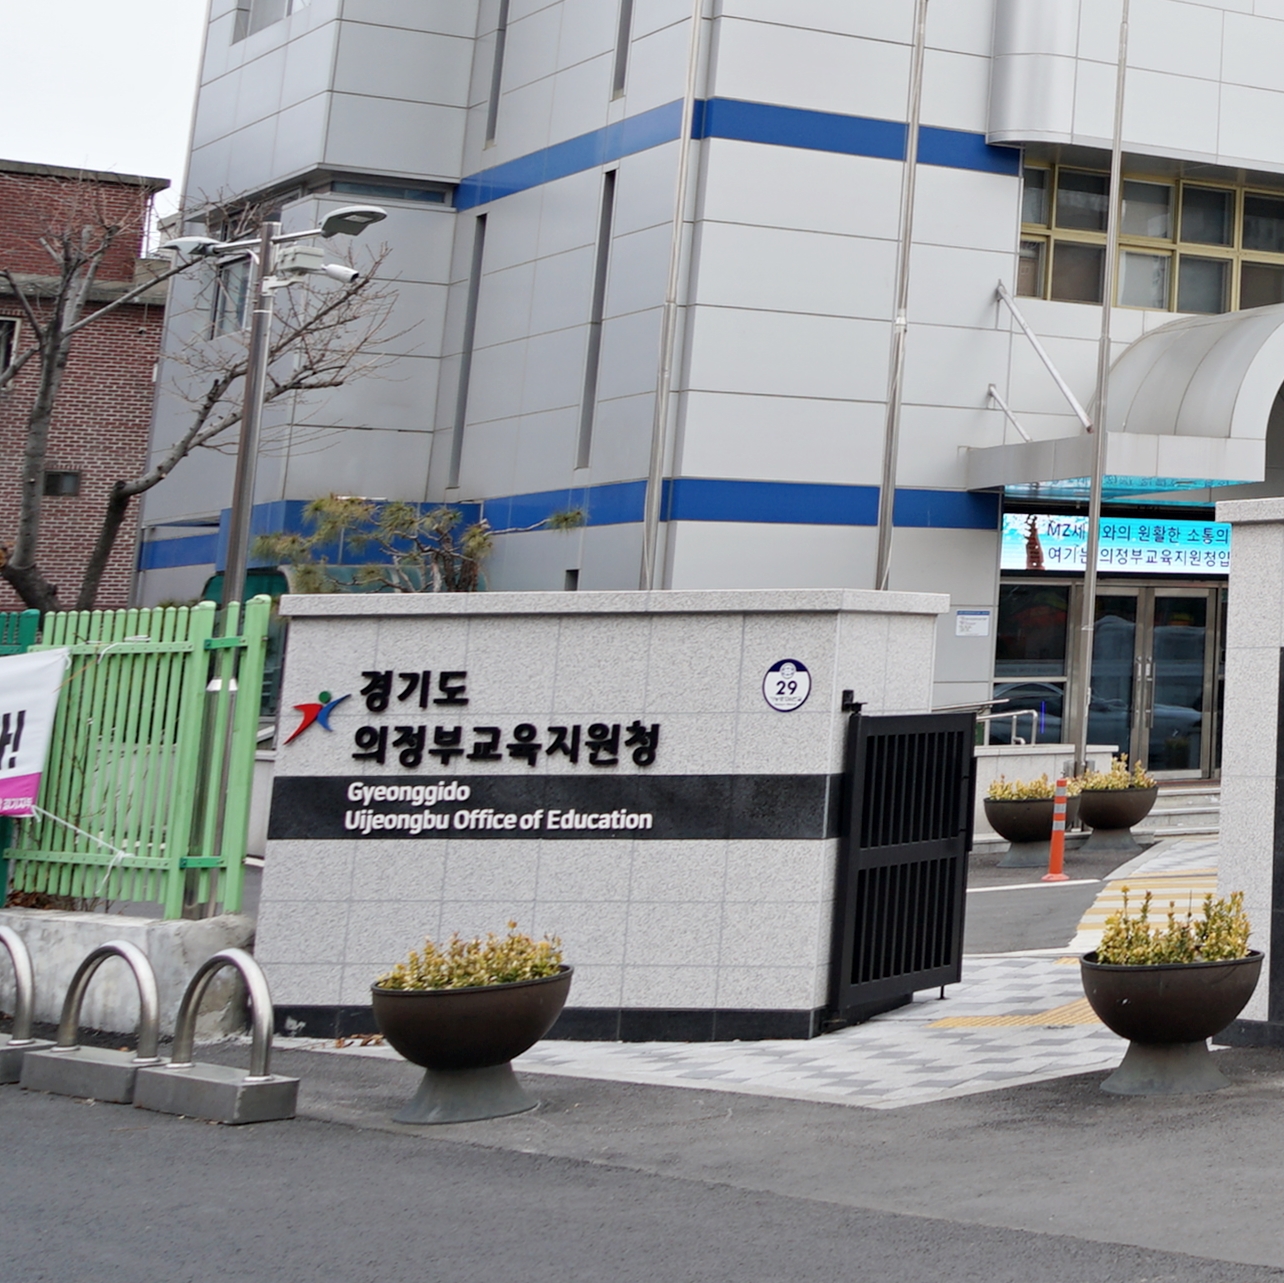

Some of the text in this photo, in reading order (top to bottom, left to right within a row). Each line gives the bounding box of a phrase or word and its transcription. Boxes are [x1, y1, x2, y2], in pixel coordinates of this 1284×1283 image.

[1047, 522, 1229, 544] MZ세와의 원활한 소통의
[359, 670, 470, 713] 경기도
[776, 680, 798, 695] 29
[351, 720, 661, 767] 의정부교육지원청
[347, 780, 471, 806] Gyeonggido
[344, 808, 654, 835] Uijeongbu Office of Education
